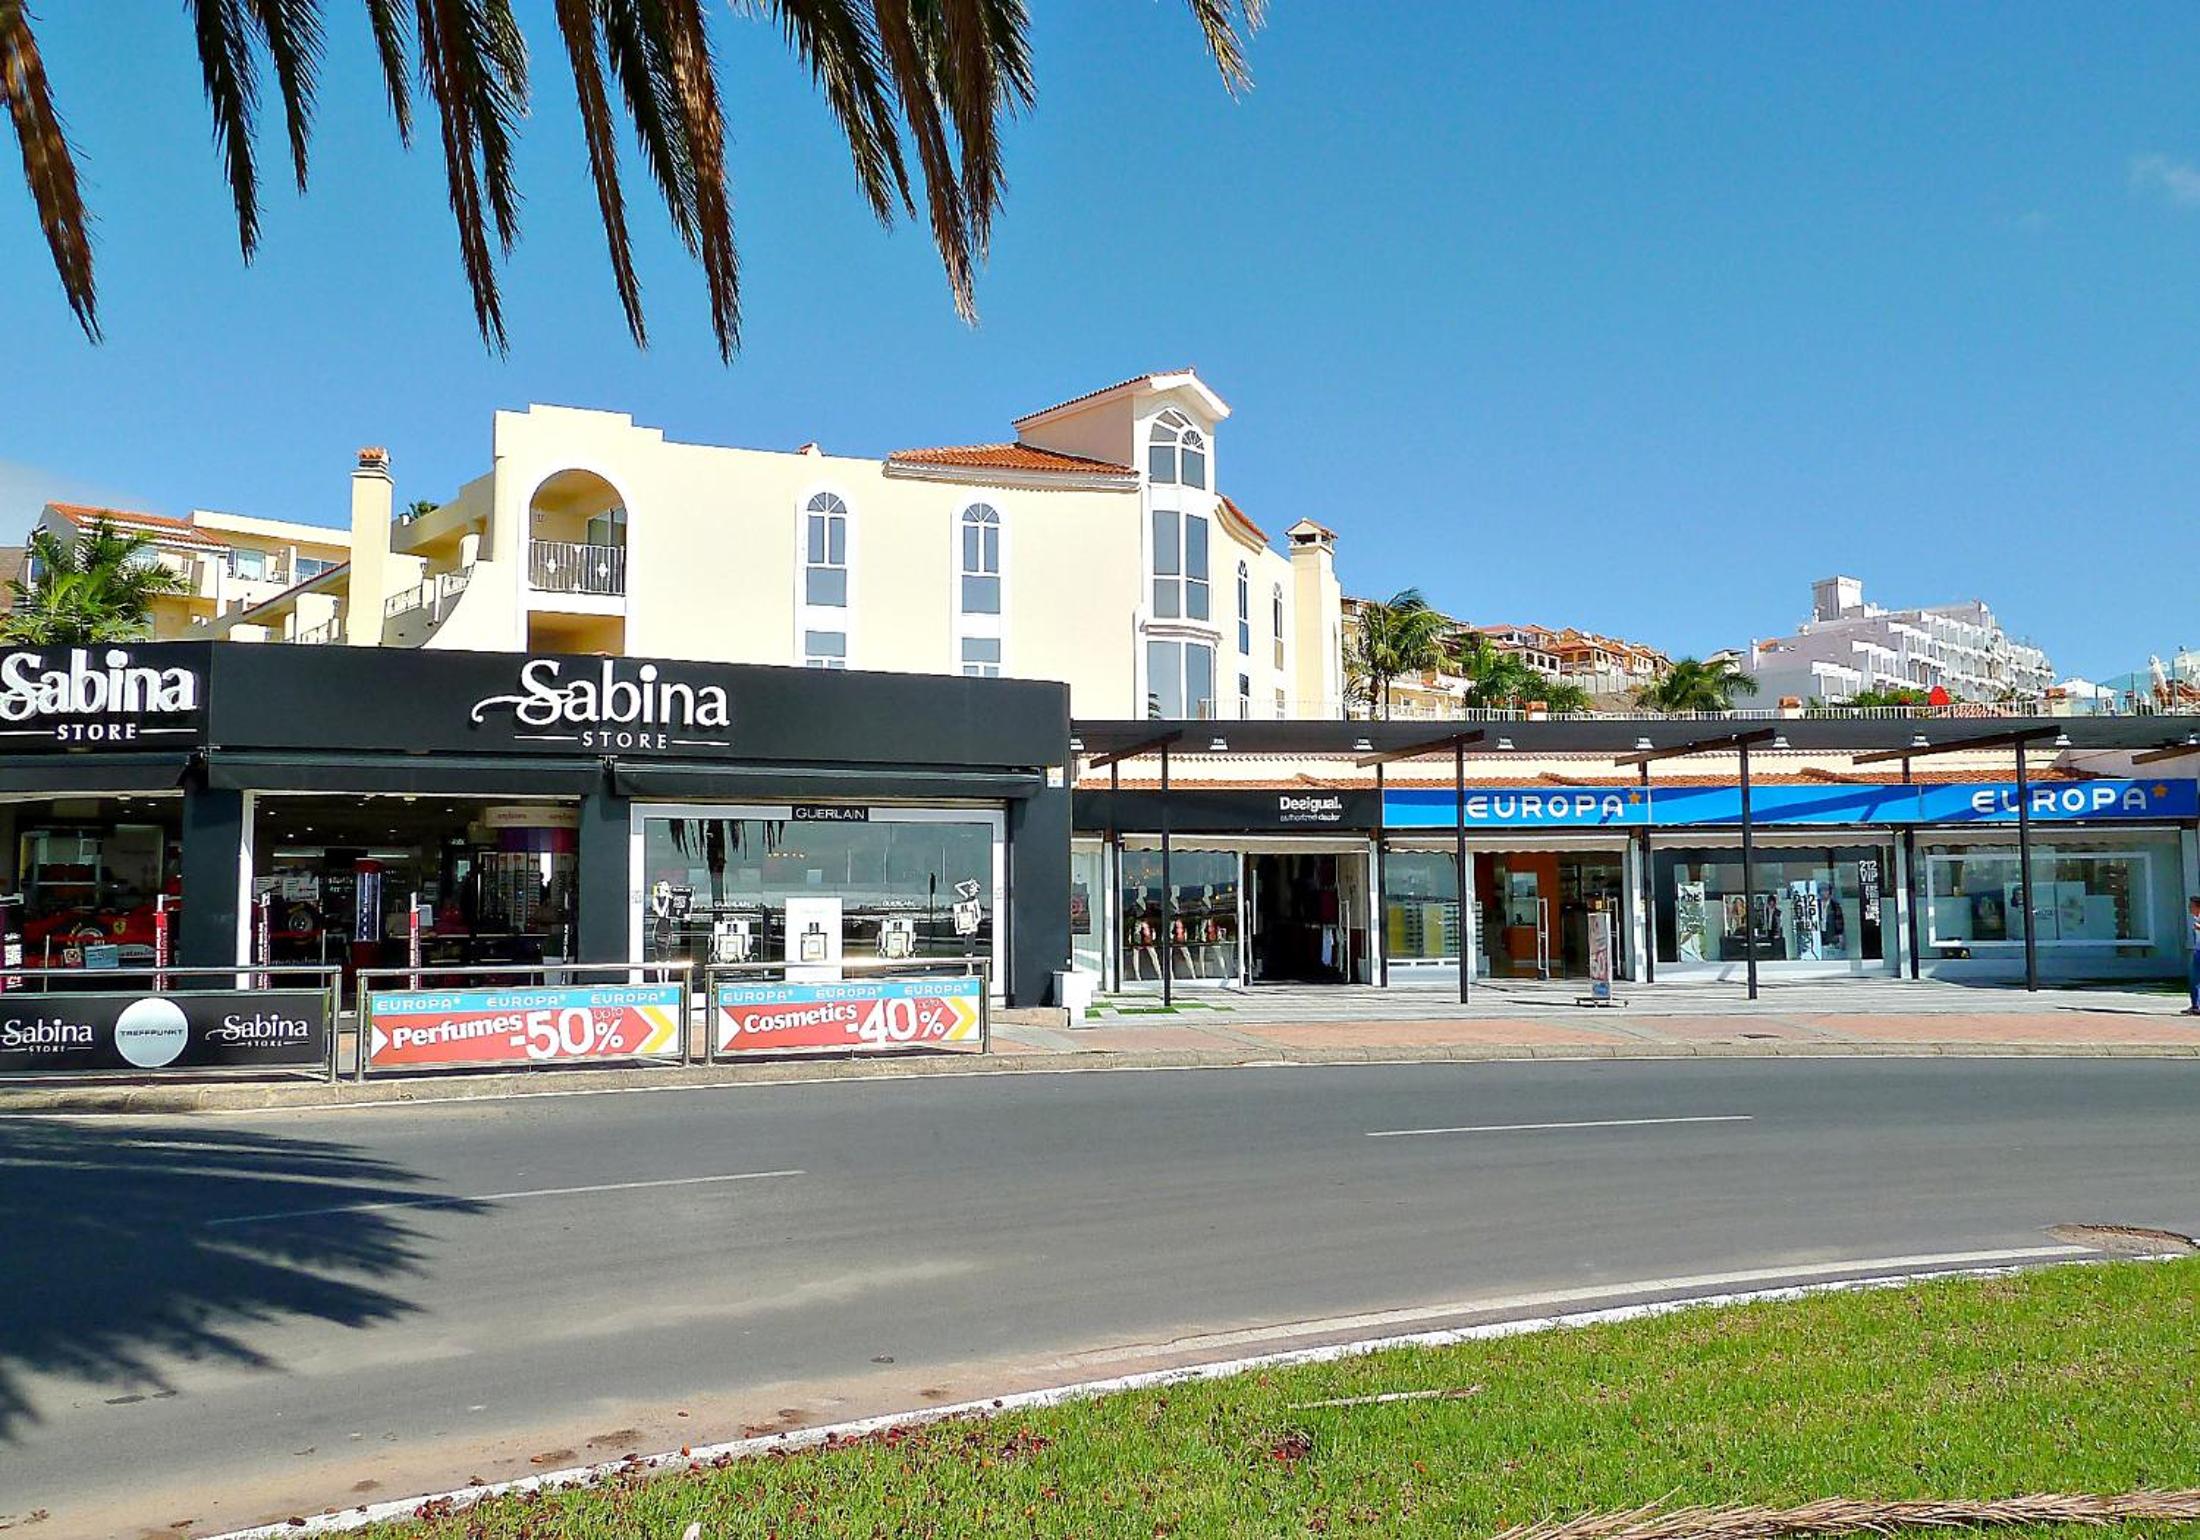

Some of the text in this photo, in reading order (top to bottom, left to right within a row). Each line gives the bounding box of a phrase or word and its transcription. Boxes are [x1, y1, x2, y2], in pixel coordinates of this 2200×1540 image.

[0, 649, 197, 721] Sabina
[471, 659, 731, 726] Sabina
[57, 723, 137, 741] STORE
[582, 731, 668, 750] STORE
[795, 807, 865, 820] GUERLAIN
[1466, 795, 1624, 819] EUROPA
[1318, 812, 1341, 821] dealer
[1859, 860, 1878, 870] 212
[1860, 870, 1878, 882] VIP
[816, 988, 877, 998] EUROPA
[904, 984, 963, 995] EUROPA
[486, 996, 559, 1009] EUROPA
[591, 992, 659, 1004] EUROPA
[723, 991, 787, 1002] EUROPA
[377, 997, 457, 1012] EUROPA
[205, 1013, 309, 1041] Sabina
[744, 997, 944, 1048] Cosmetics -40%
[0, 1018, 93, 1047] Sabina
[120, 1029, 184, 1037] TREFFPUNKT
[392, 1007, 624, 1060] Perfumes -50%
[28, 1044, 66, 1053] STORE
[247, 1039, 283, 1048] STORE
